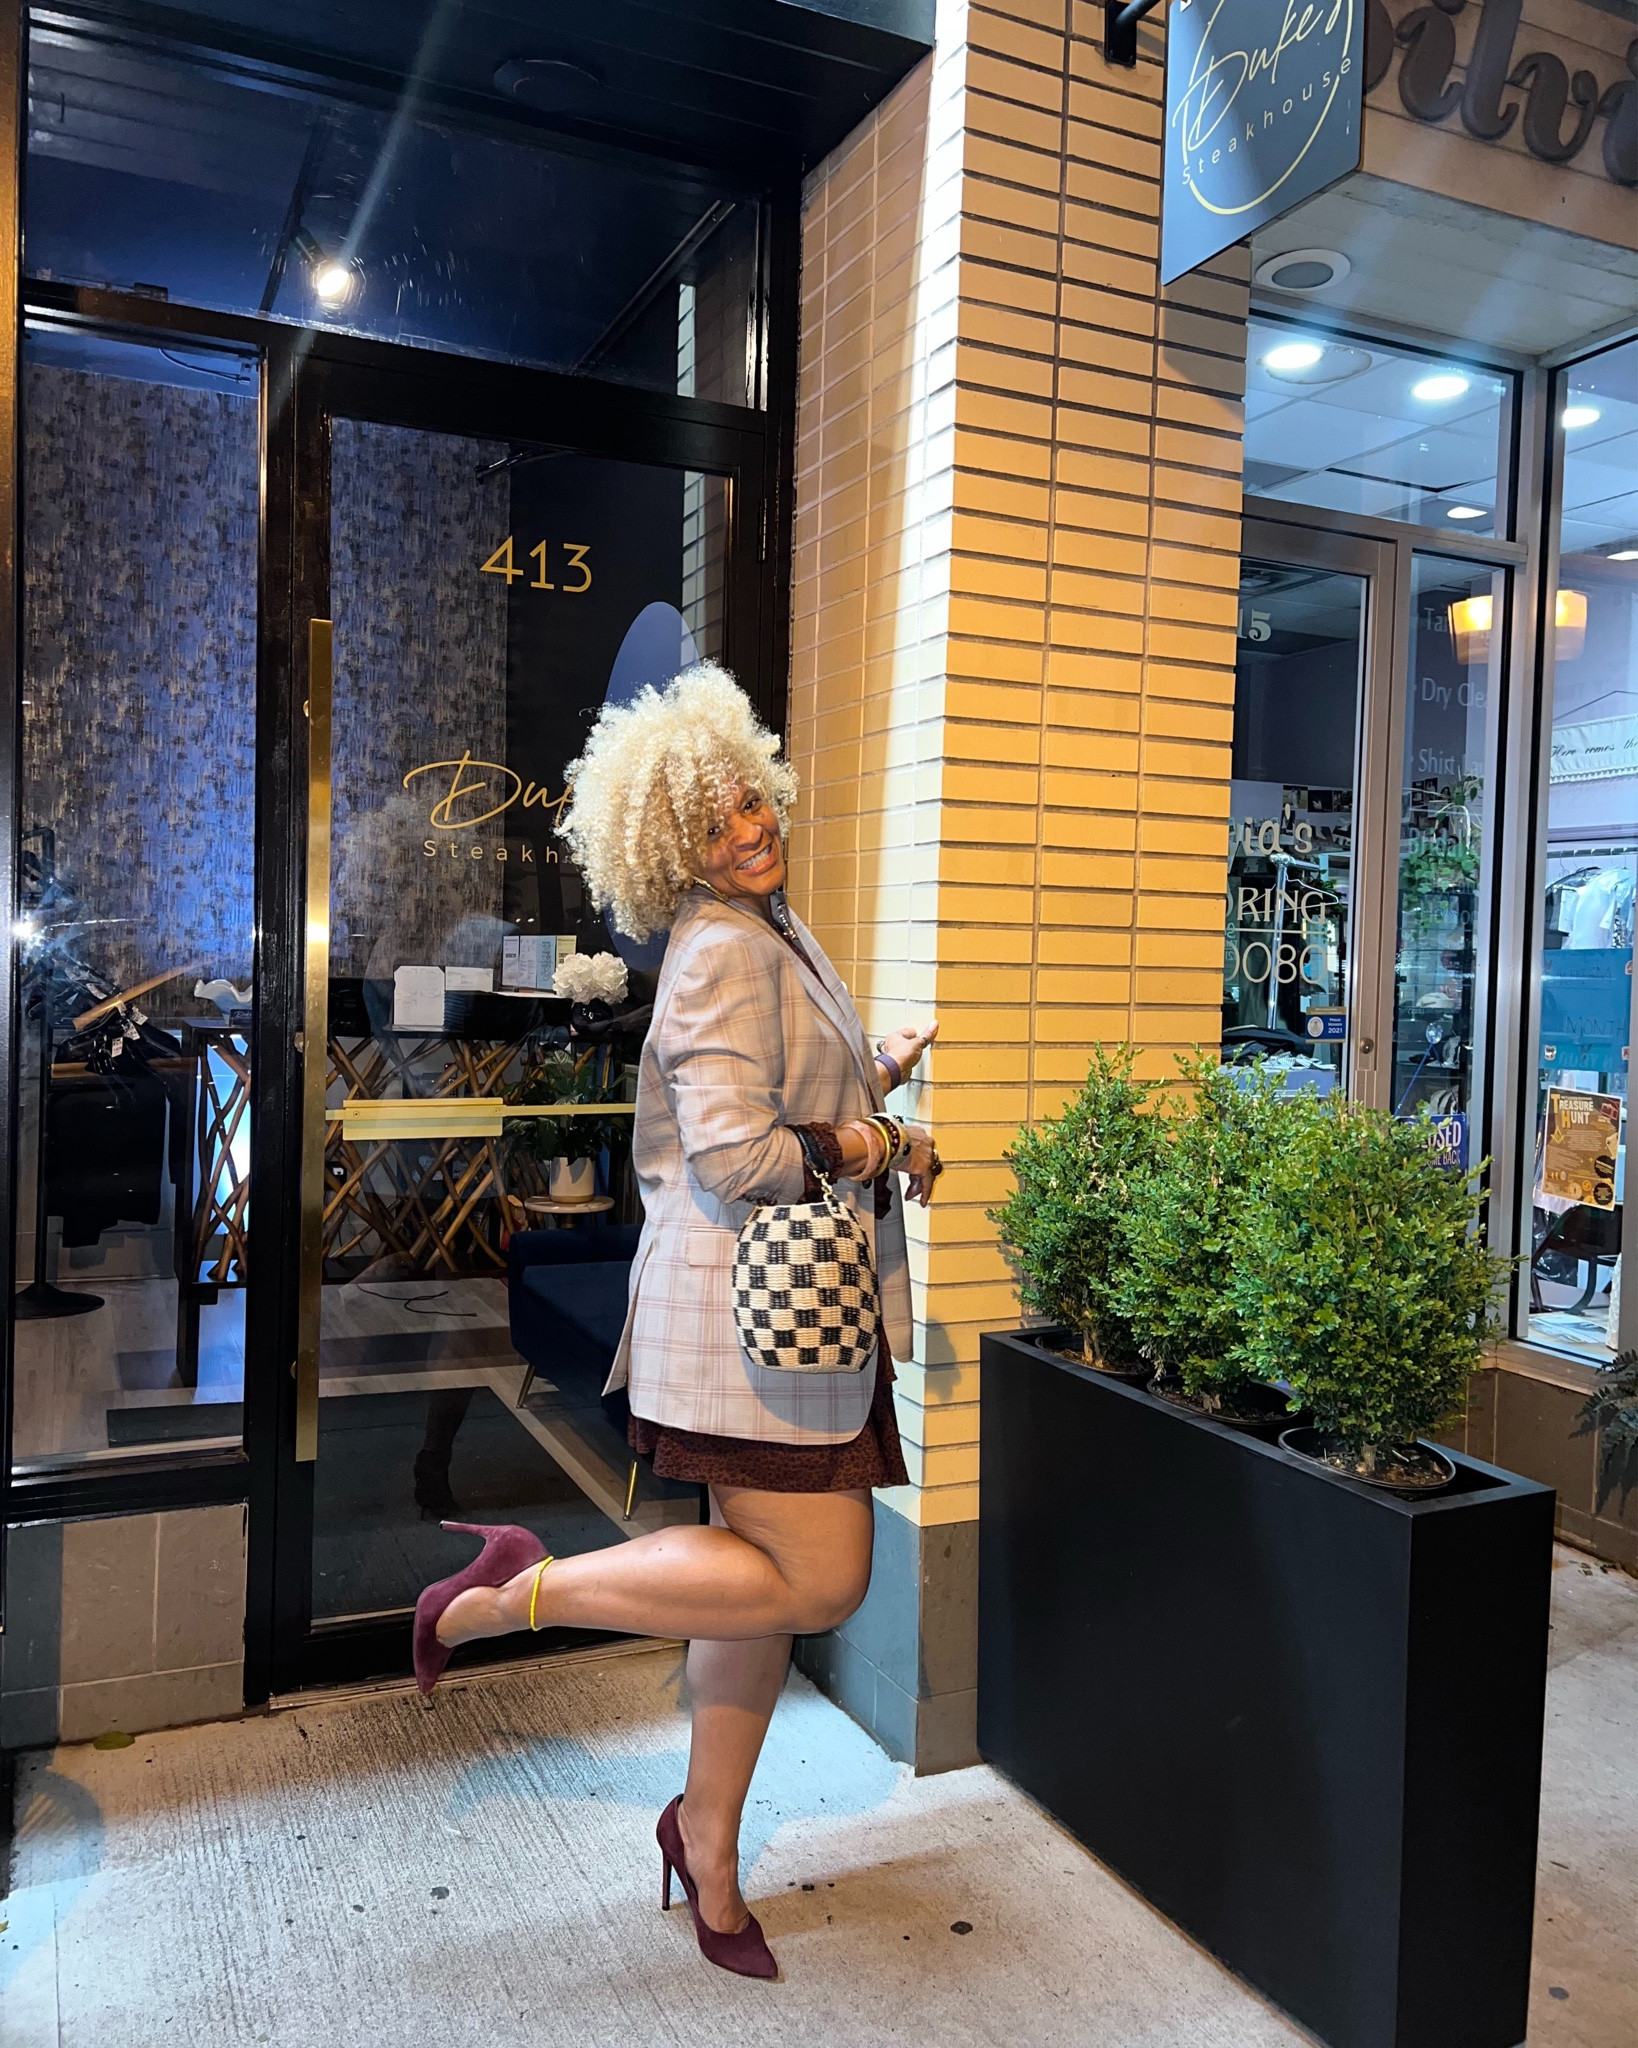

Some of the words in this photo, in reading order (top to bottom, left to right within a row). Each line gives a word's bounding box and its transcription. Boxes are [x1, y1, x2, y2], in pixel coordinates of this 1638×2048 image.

[1182, 57, 1351, 185] Steakhouse
[480, 535, 592, 594] 413
[1421, 677, 1452, 710] Dry
[1457, 682, 1487, 708] Cle
[1418, 747, 1455, 775] Shirt
[1243, 803, 1313, 855] ia's
[423, 840, 559, 864] Steakh
[1550, 1093, 1594, 1114] TREASURE
[1561, 1110, 1590, 1129] HUNT
